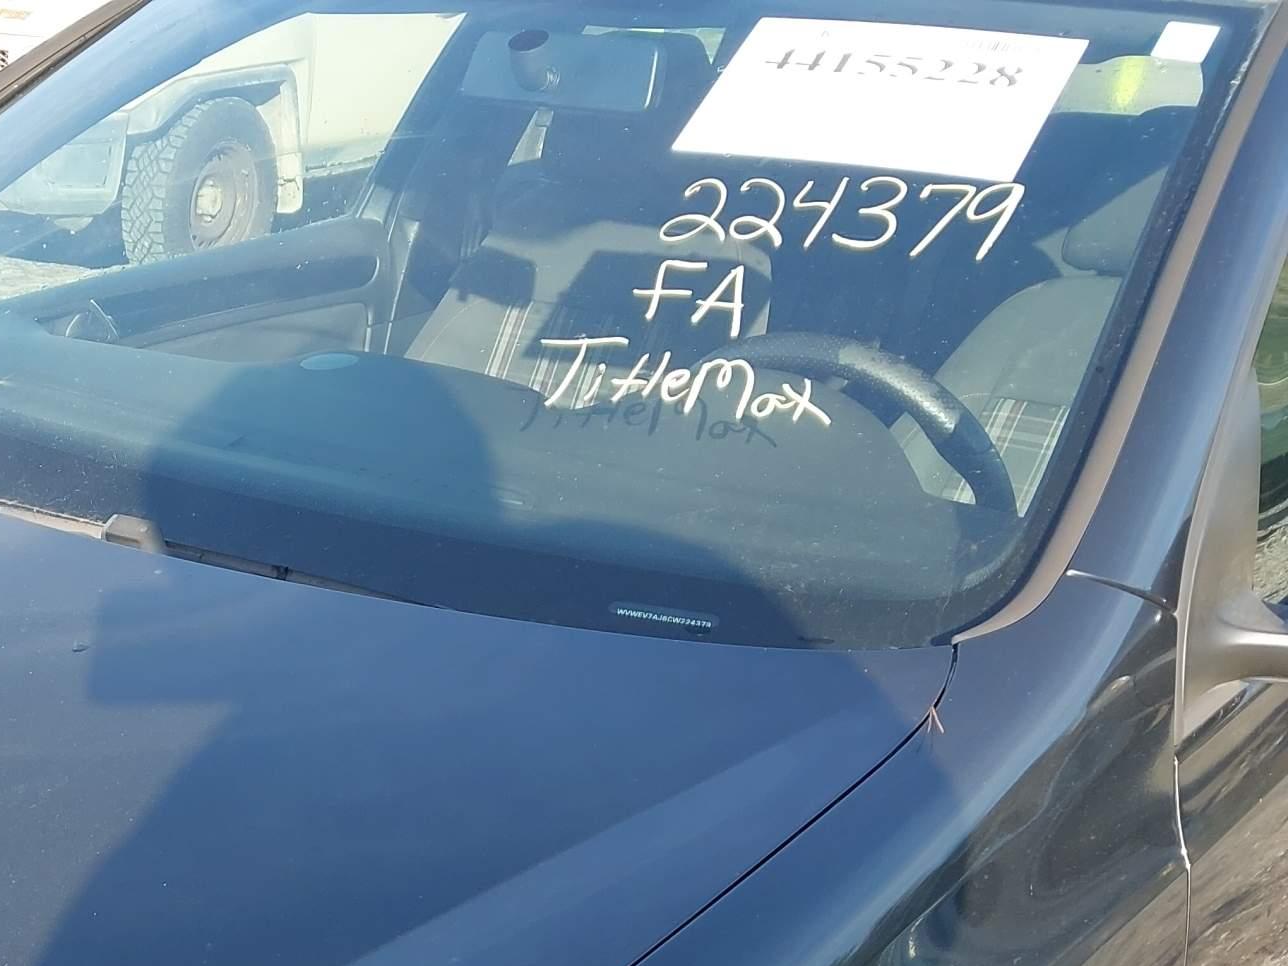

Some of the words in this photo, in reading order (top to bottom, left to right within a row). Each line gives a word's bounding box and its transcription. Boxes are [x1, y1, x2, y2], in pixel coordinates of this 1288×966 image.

[764, 48, 1024, 87] 44155228
[658, 176, 1026, 262] 224379
[632, 259, 746, 339] FA
[540, 335, 832, 427] TitleMax
